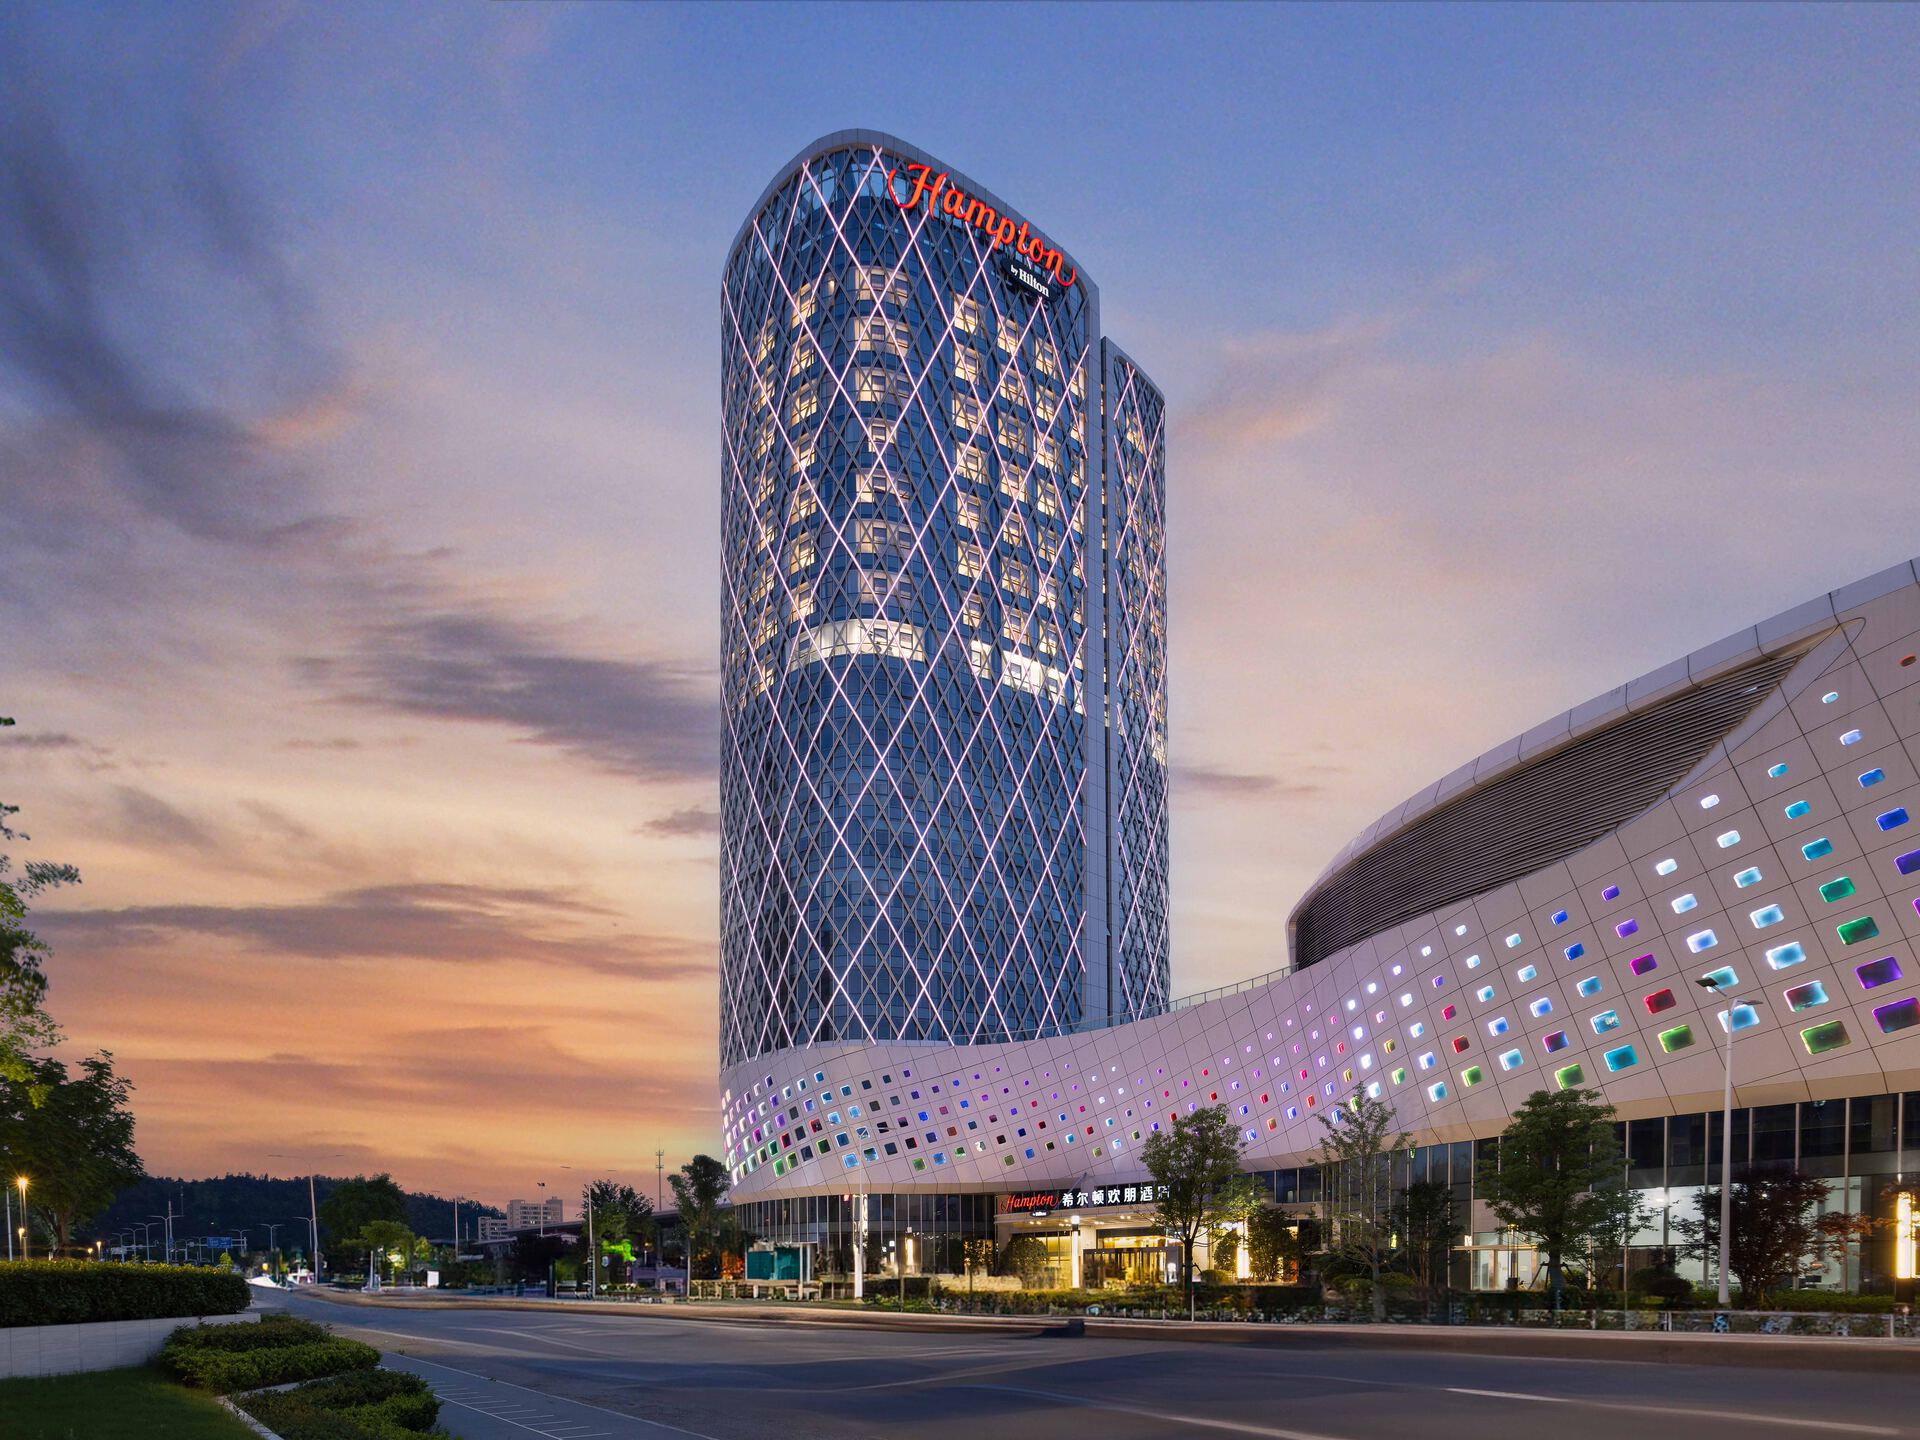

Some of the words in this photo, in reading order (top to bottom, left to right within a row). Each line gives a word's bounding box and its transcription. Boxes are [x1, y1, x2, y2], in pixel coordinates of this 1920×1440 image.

[887, 164, 1076, 287] Hampton
[1010, 264, 1019, 276] by
[1019, 268, 1049, 298] Hilton
[1000, 1193, 1059, 1214] Hampton
